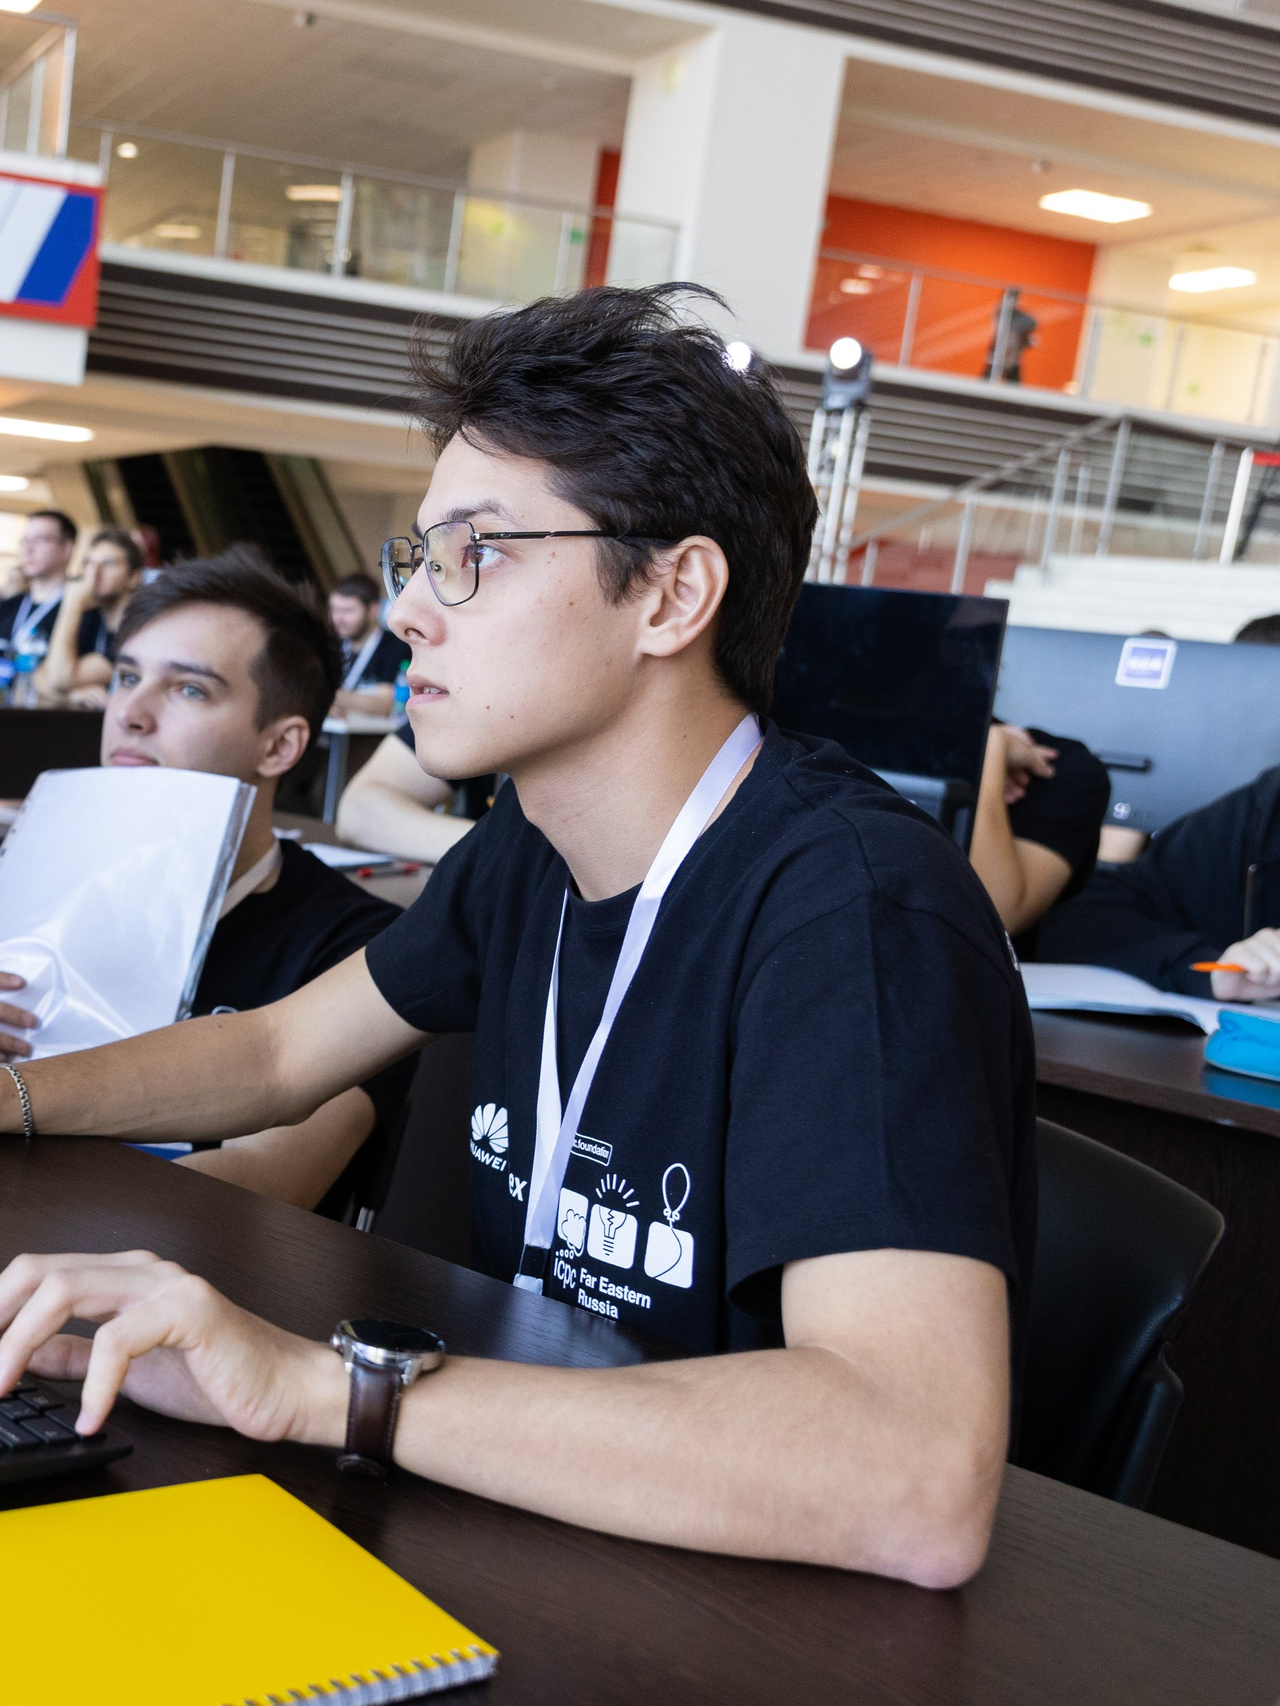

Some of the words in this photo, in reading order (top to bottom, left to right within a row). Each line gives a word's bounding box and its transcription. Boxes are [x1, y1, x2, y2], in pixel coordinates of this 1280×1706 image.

[553, 1250, 577, 1289] icpc
[579, 1267, 597, 1289] Far
[599, 1276, 652, 1309] Eastern
[577, 1288, 619, 1319] Russia
